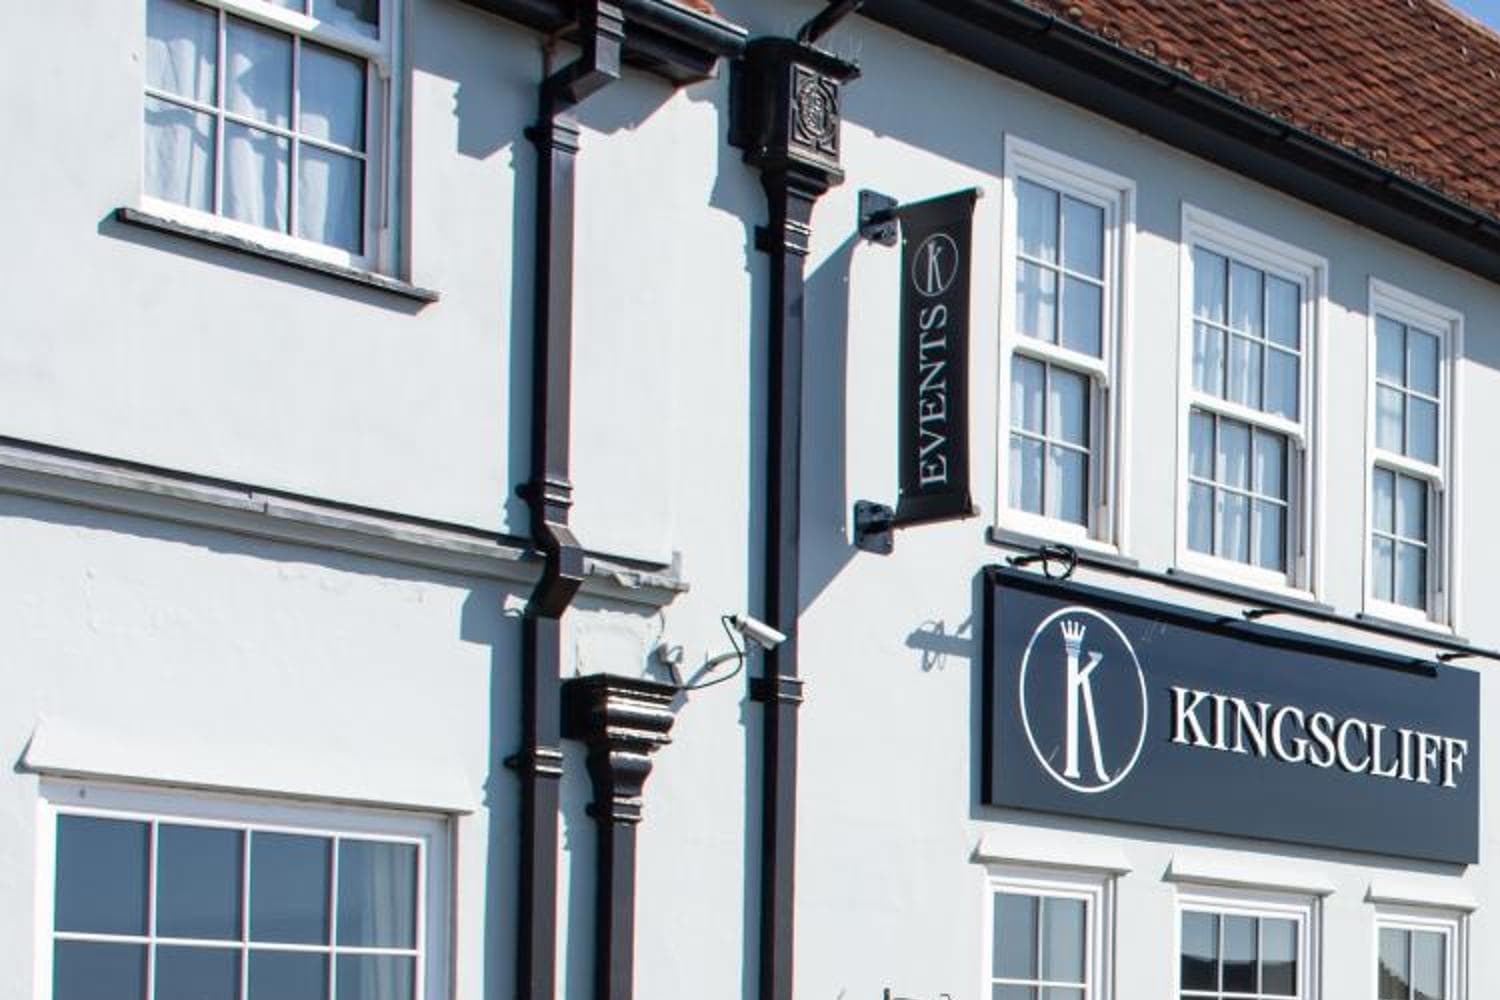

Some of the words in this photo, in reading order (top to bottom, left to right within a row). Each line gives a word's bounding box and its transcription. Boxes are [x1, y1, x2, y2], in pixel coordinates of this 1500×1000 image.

[919, 303, 948, 487] EVENTS
[1060, 620, 1111, 783] K
[1169, 686, 1469, 789] KINGSCLIFF
